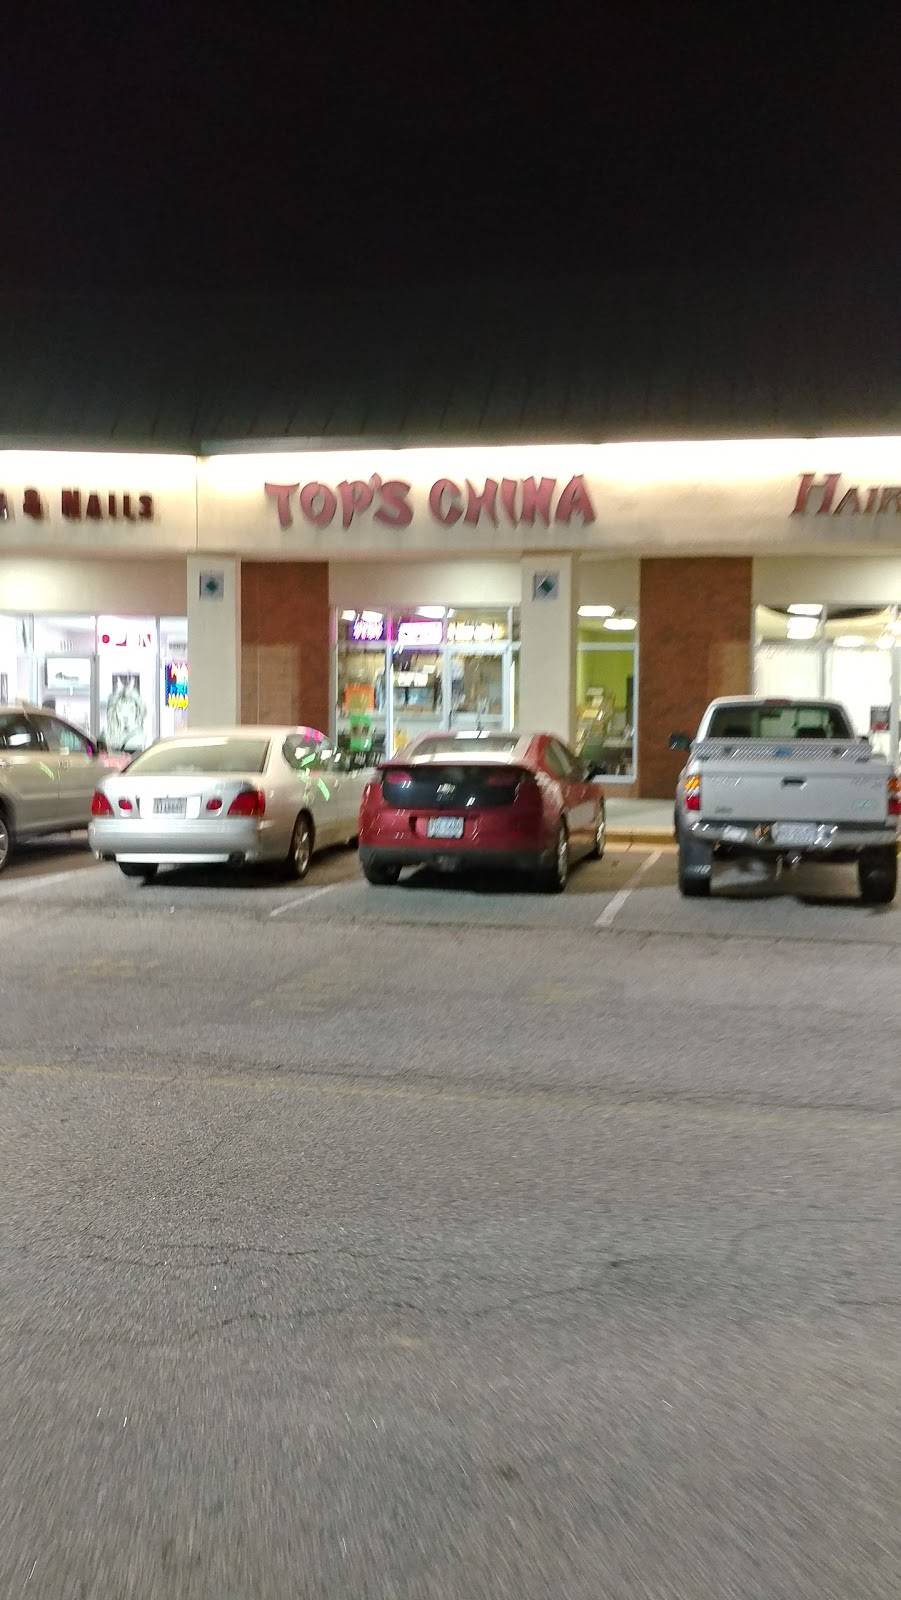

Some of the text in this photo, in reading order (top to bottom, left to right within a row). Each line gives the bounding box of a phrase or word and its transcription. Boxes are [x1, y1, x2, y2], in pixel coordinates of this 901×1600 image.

[62, 488, 155, 521] NAILS
[264, 472, 597, 530] TOP'S CHINA
